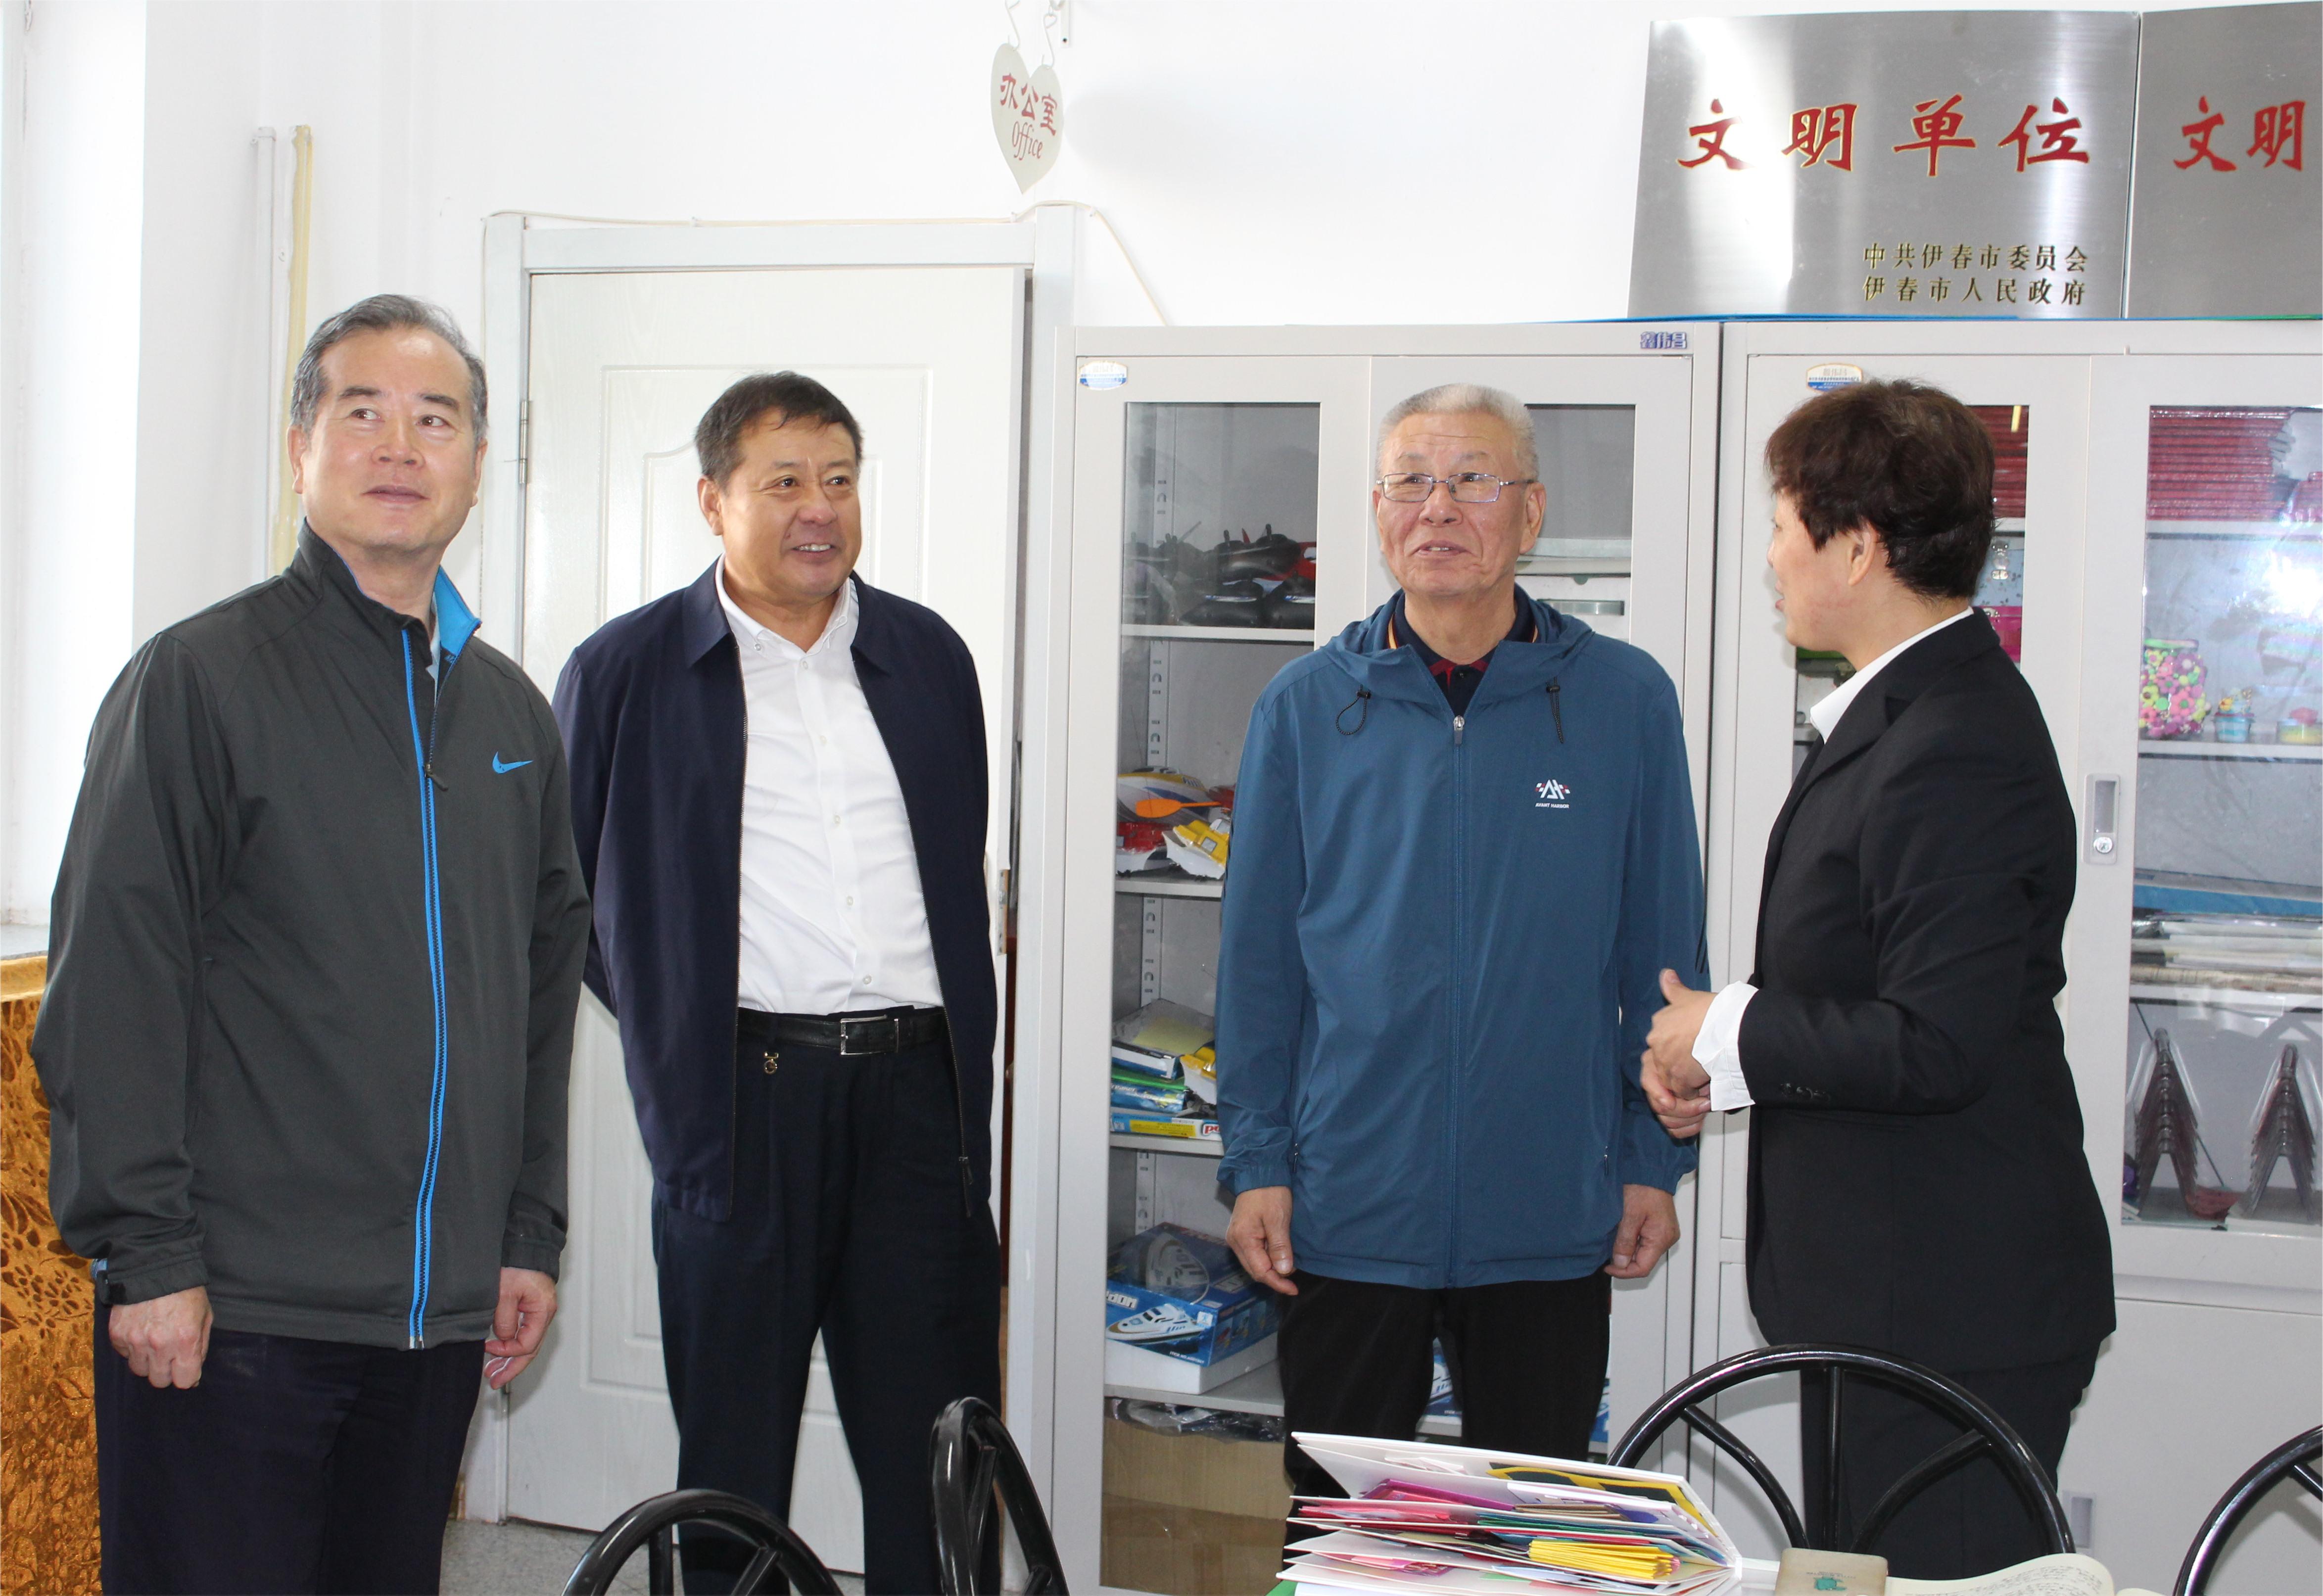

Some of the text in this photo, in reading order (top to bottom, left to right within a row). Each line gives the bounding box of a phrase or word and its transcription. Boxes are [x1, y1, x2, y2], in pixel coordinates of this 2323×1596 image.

[1000, 73, 1057, 136] 办公室
[1012, 121, 1043, 160] Office
[1677, 93, 2089, 177] 文明单位
[2174, 95, 2306, 172] 文明
[1863, 242, 2087, 272] 中共伊春市委员会
[1862, 275, 2085, 305] 伊春市人民政府
